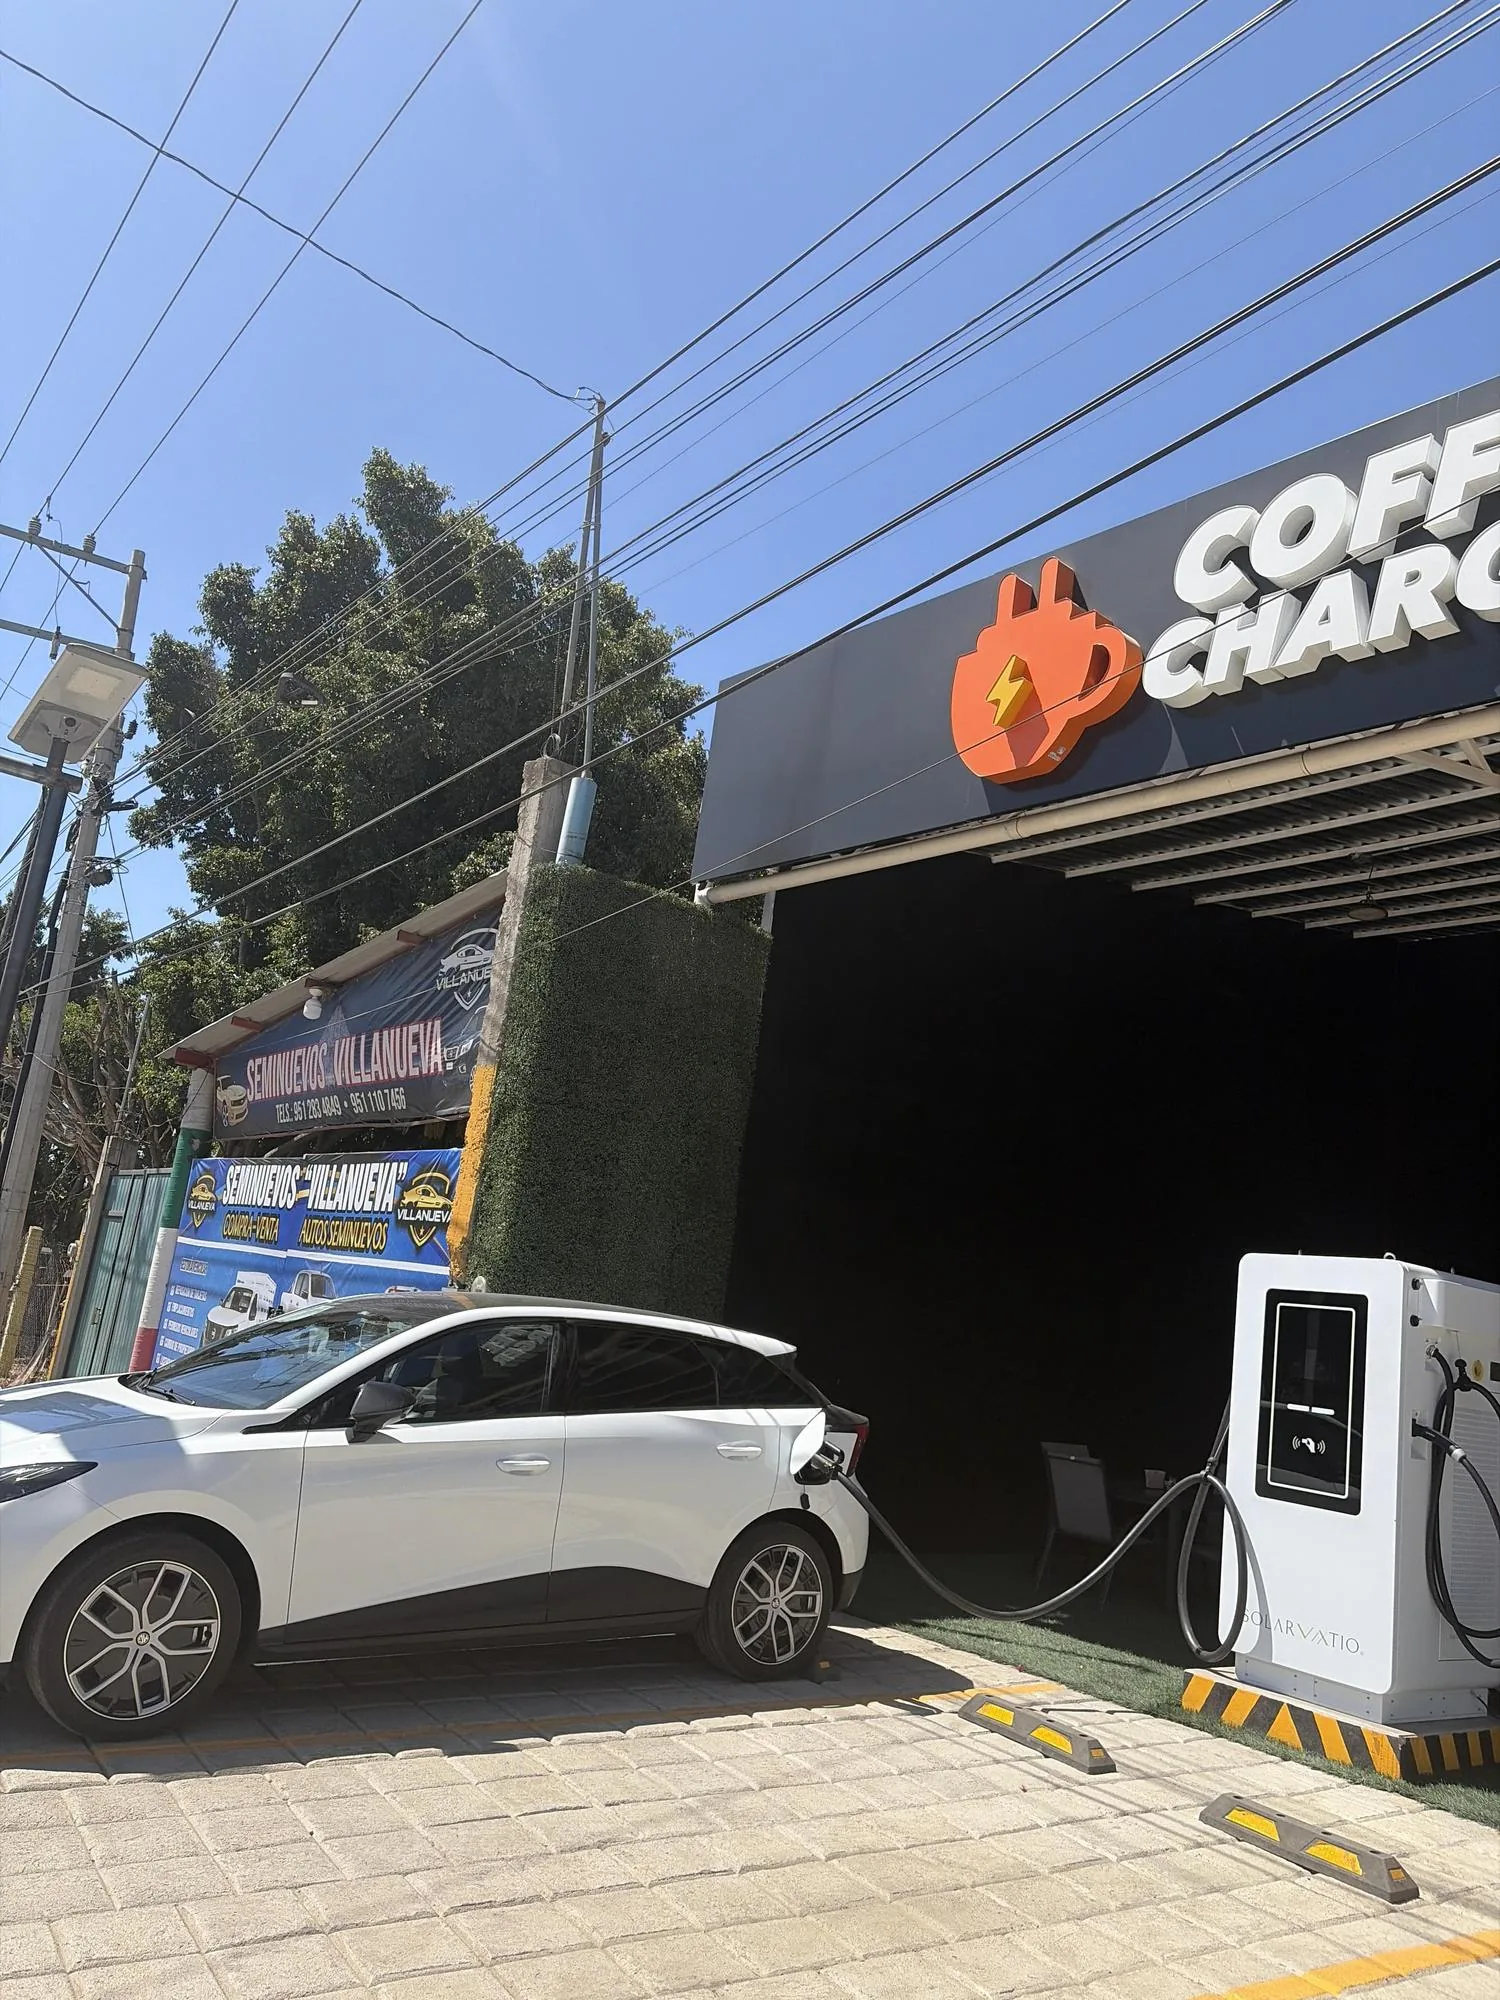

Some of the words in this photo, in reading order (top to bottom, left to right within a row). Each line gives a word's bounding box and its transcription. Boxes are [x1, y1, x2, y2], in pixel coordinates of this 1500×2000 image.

[436, 964, 492, 991] VILLANUE
[246, 1041, 328, 1101] SEMINUEVOS
[333, 1018, 444, 1087] VILLANUEVA
[293, 1100, 307, 1121] 951
[321, 1094, 342, 1117] 4849
[350, 1091, 368, 1114] 951
[367, 1090, 385, 1112] 110
[383, 1086, 407, 1111] 7456
[222, 1164, 301, 1210] SEMINUEVOS
[299, 1218, 329, 1246] AUTOS
[327, 1219, 388, 1250] SEMINUEVOS
